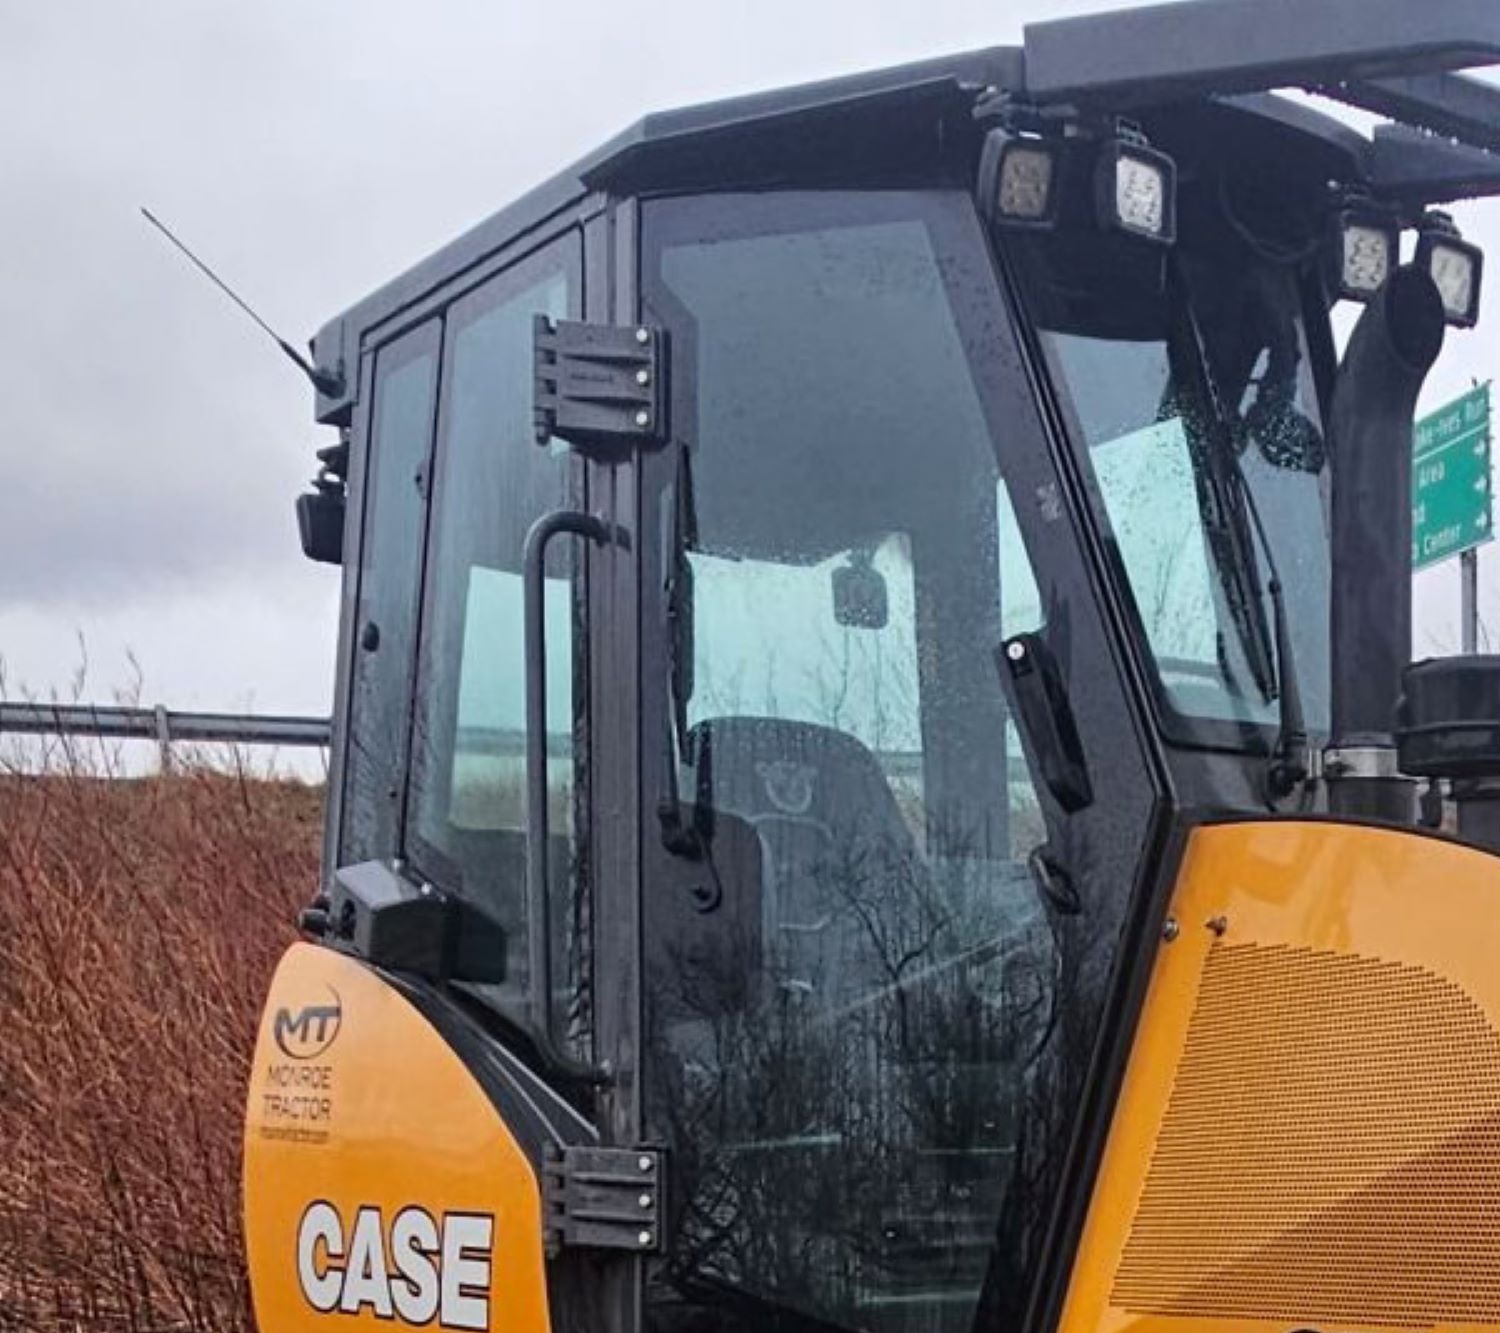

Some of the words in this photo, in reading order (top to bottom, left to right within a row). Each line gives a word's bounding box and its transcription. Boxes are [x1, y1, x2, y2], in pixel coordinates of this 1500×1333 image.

[274, 1004, 342, 1046] MT
[266, 1064, 332, 1090] MONROE
[262, 1093, 332, 1121] TRACTOR
[297, 1199, 494, 1333] CASE
